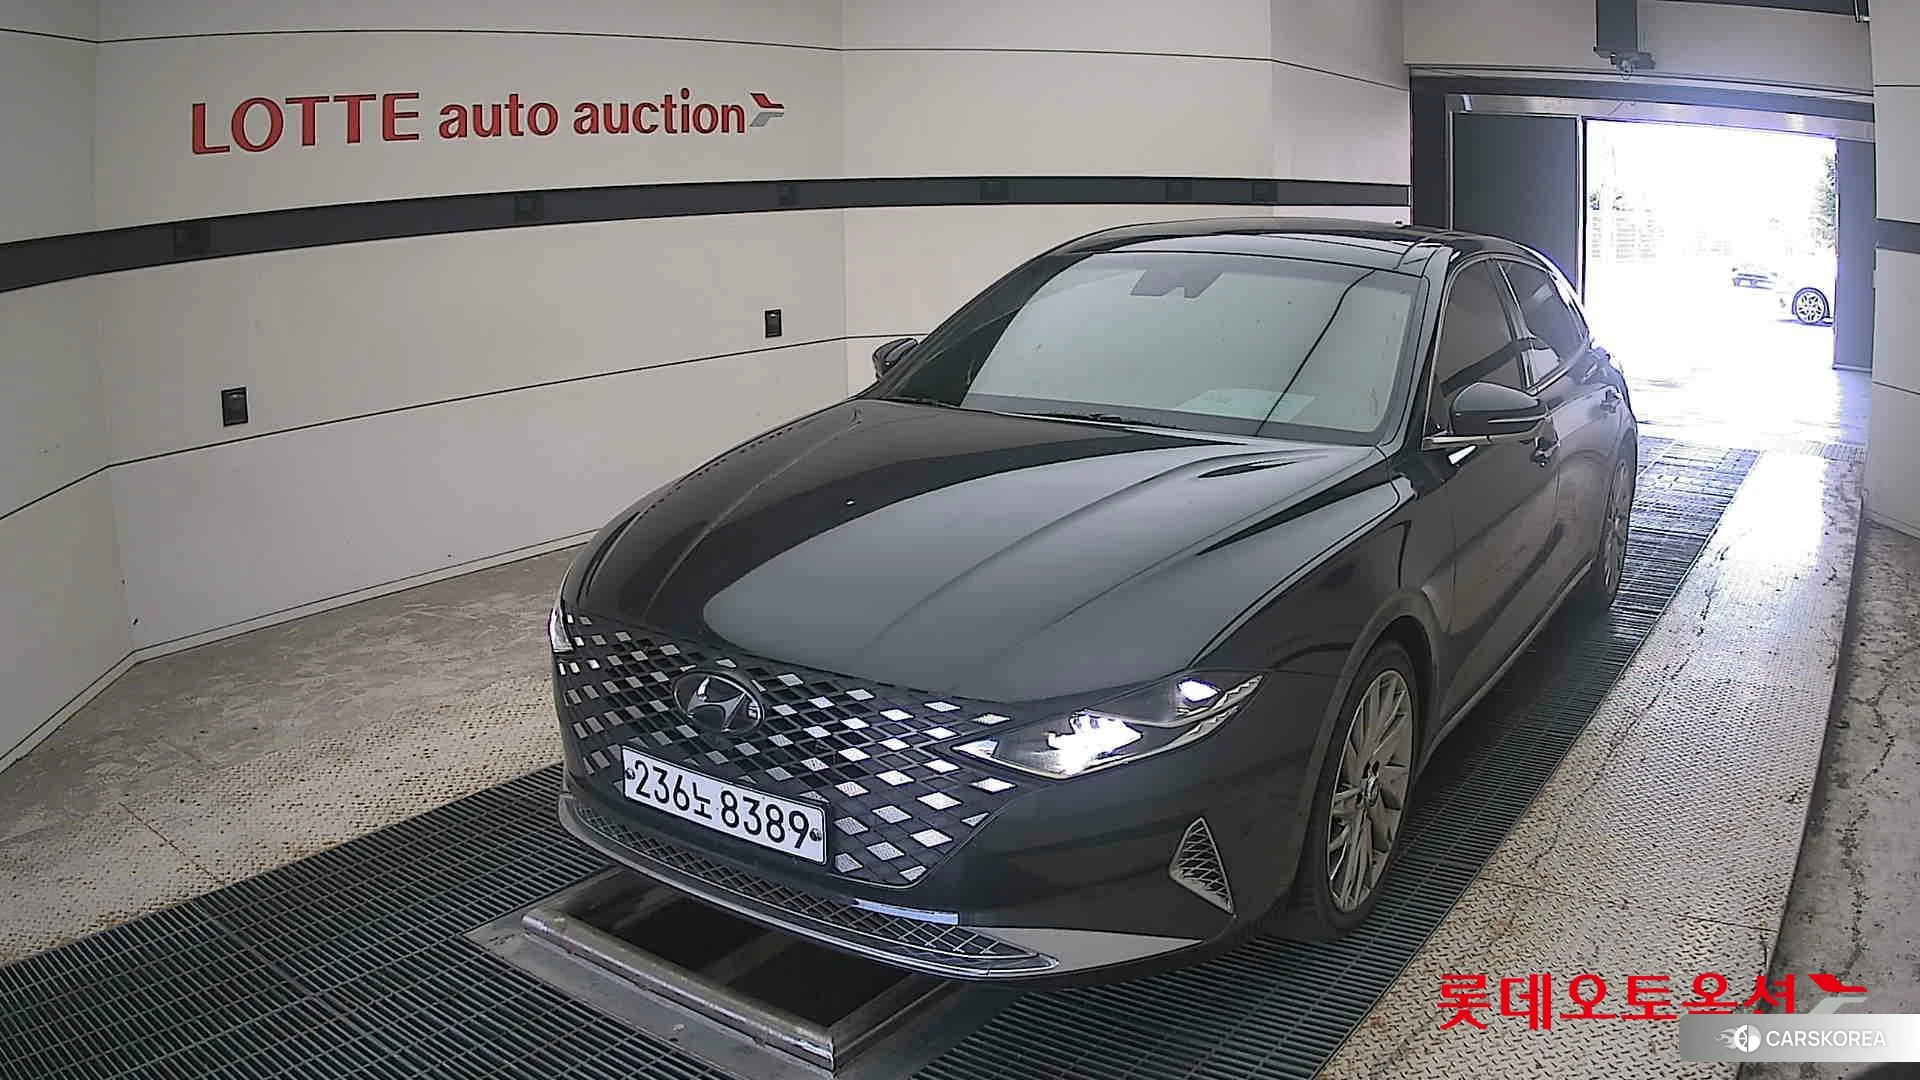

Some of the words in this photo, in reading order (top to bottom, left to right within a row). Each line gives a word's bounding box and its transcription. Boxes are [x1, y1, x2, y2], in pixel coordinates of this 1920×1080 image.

[192, 92, 420, 155] LOTTE
[438, 93, 559, 140] auto
[572, 87, 746, 136] auction
[719, 790, 810, 849] 8389
